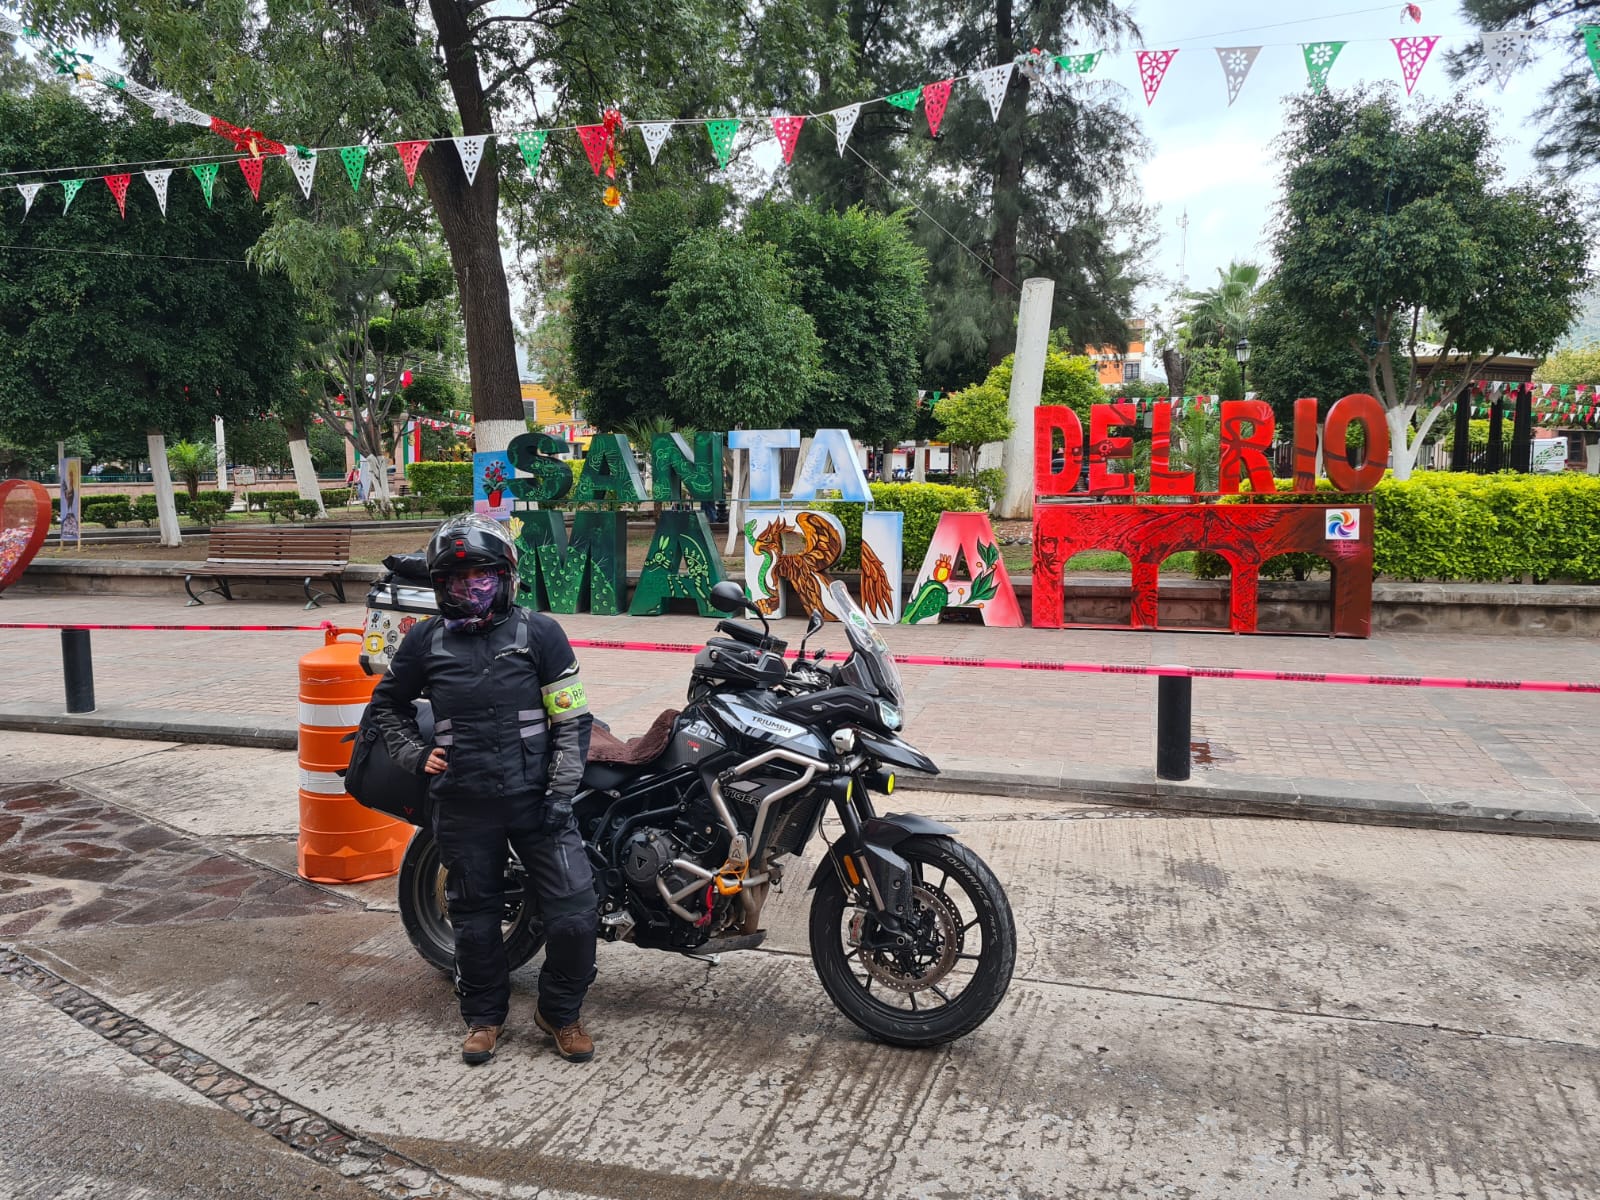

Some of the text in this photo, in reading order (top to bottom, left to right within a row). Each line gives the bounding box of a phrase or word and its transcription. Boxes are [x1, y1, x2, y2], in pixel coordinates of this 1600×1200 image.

[507, 428, 874, 501] SANTA
[510, 508, 1025, 628] MARIA
[752, 716, 792, 733] TRIUMPH
[724, 788, 762, 806] TIGER
[941, 851, 993, 909] TOURANCE
